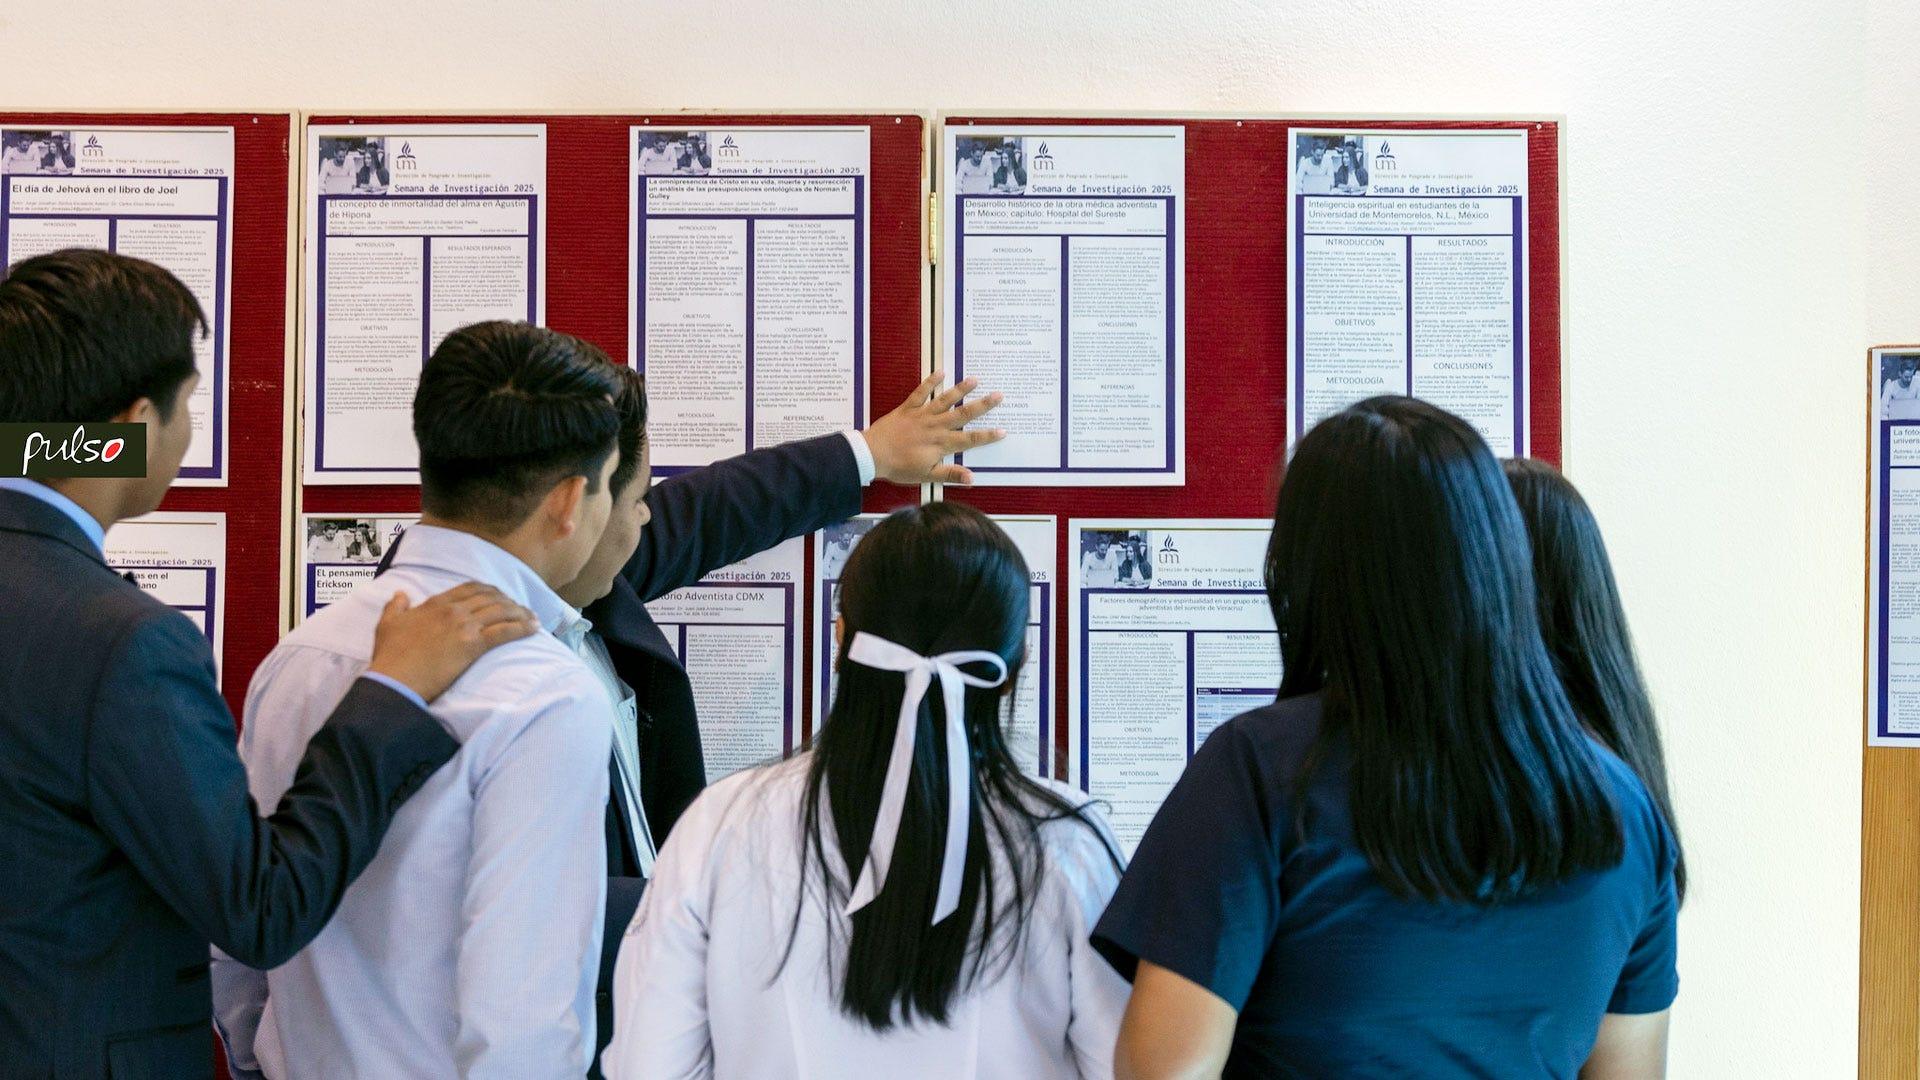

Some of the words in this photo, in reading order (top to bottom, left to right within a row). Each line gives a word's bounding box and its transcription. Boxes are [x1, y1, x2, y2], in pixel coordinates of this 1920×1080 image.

[132, 168, 199, 176] Investigación
[768, 167, 835, 175] Investigación
[12, 185, 22, 193] El
[24, 185, 39, 193] día
[42, 185, 53, 193] de
[56, 185, 91, 193] Jehová
[108, 186, 117, 194] el
[119, 186, 141, 194] libro
[143, 186, 155, 194] de
[158, 186, 178, 194] Joel
[444, 184, 510, 194] Investigación
[1082, 185, 1147, 194] Investigación
[1425, 185, 1493, 194] Investigación
[338, 200, 377, 209] concepto
[495, 200, 526, 209] Agustín
[1308, 201, 1355, 210] Inteligencia
[1357, 201, 1395, 210] espiritual
[341, 211, 370, 219] Hipona
[1046, 210, 1080, 218] Hospital
[1372, 211, 1434, 219] Montemorelos,
[703, 572, 766, 582] nvestigación
[771, 572, 791, 580] 2025
[317, 580, 352, 588] Erickson
[1157, 579, 1187, 587] Semana
[1192, 579, 1202, 587] de
[685, 592, 733, 601] Adventista
[736, 592, 764, 601] CDMX
